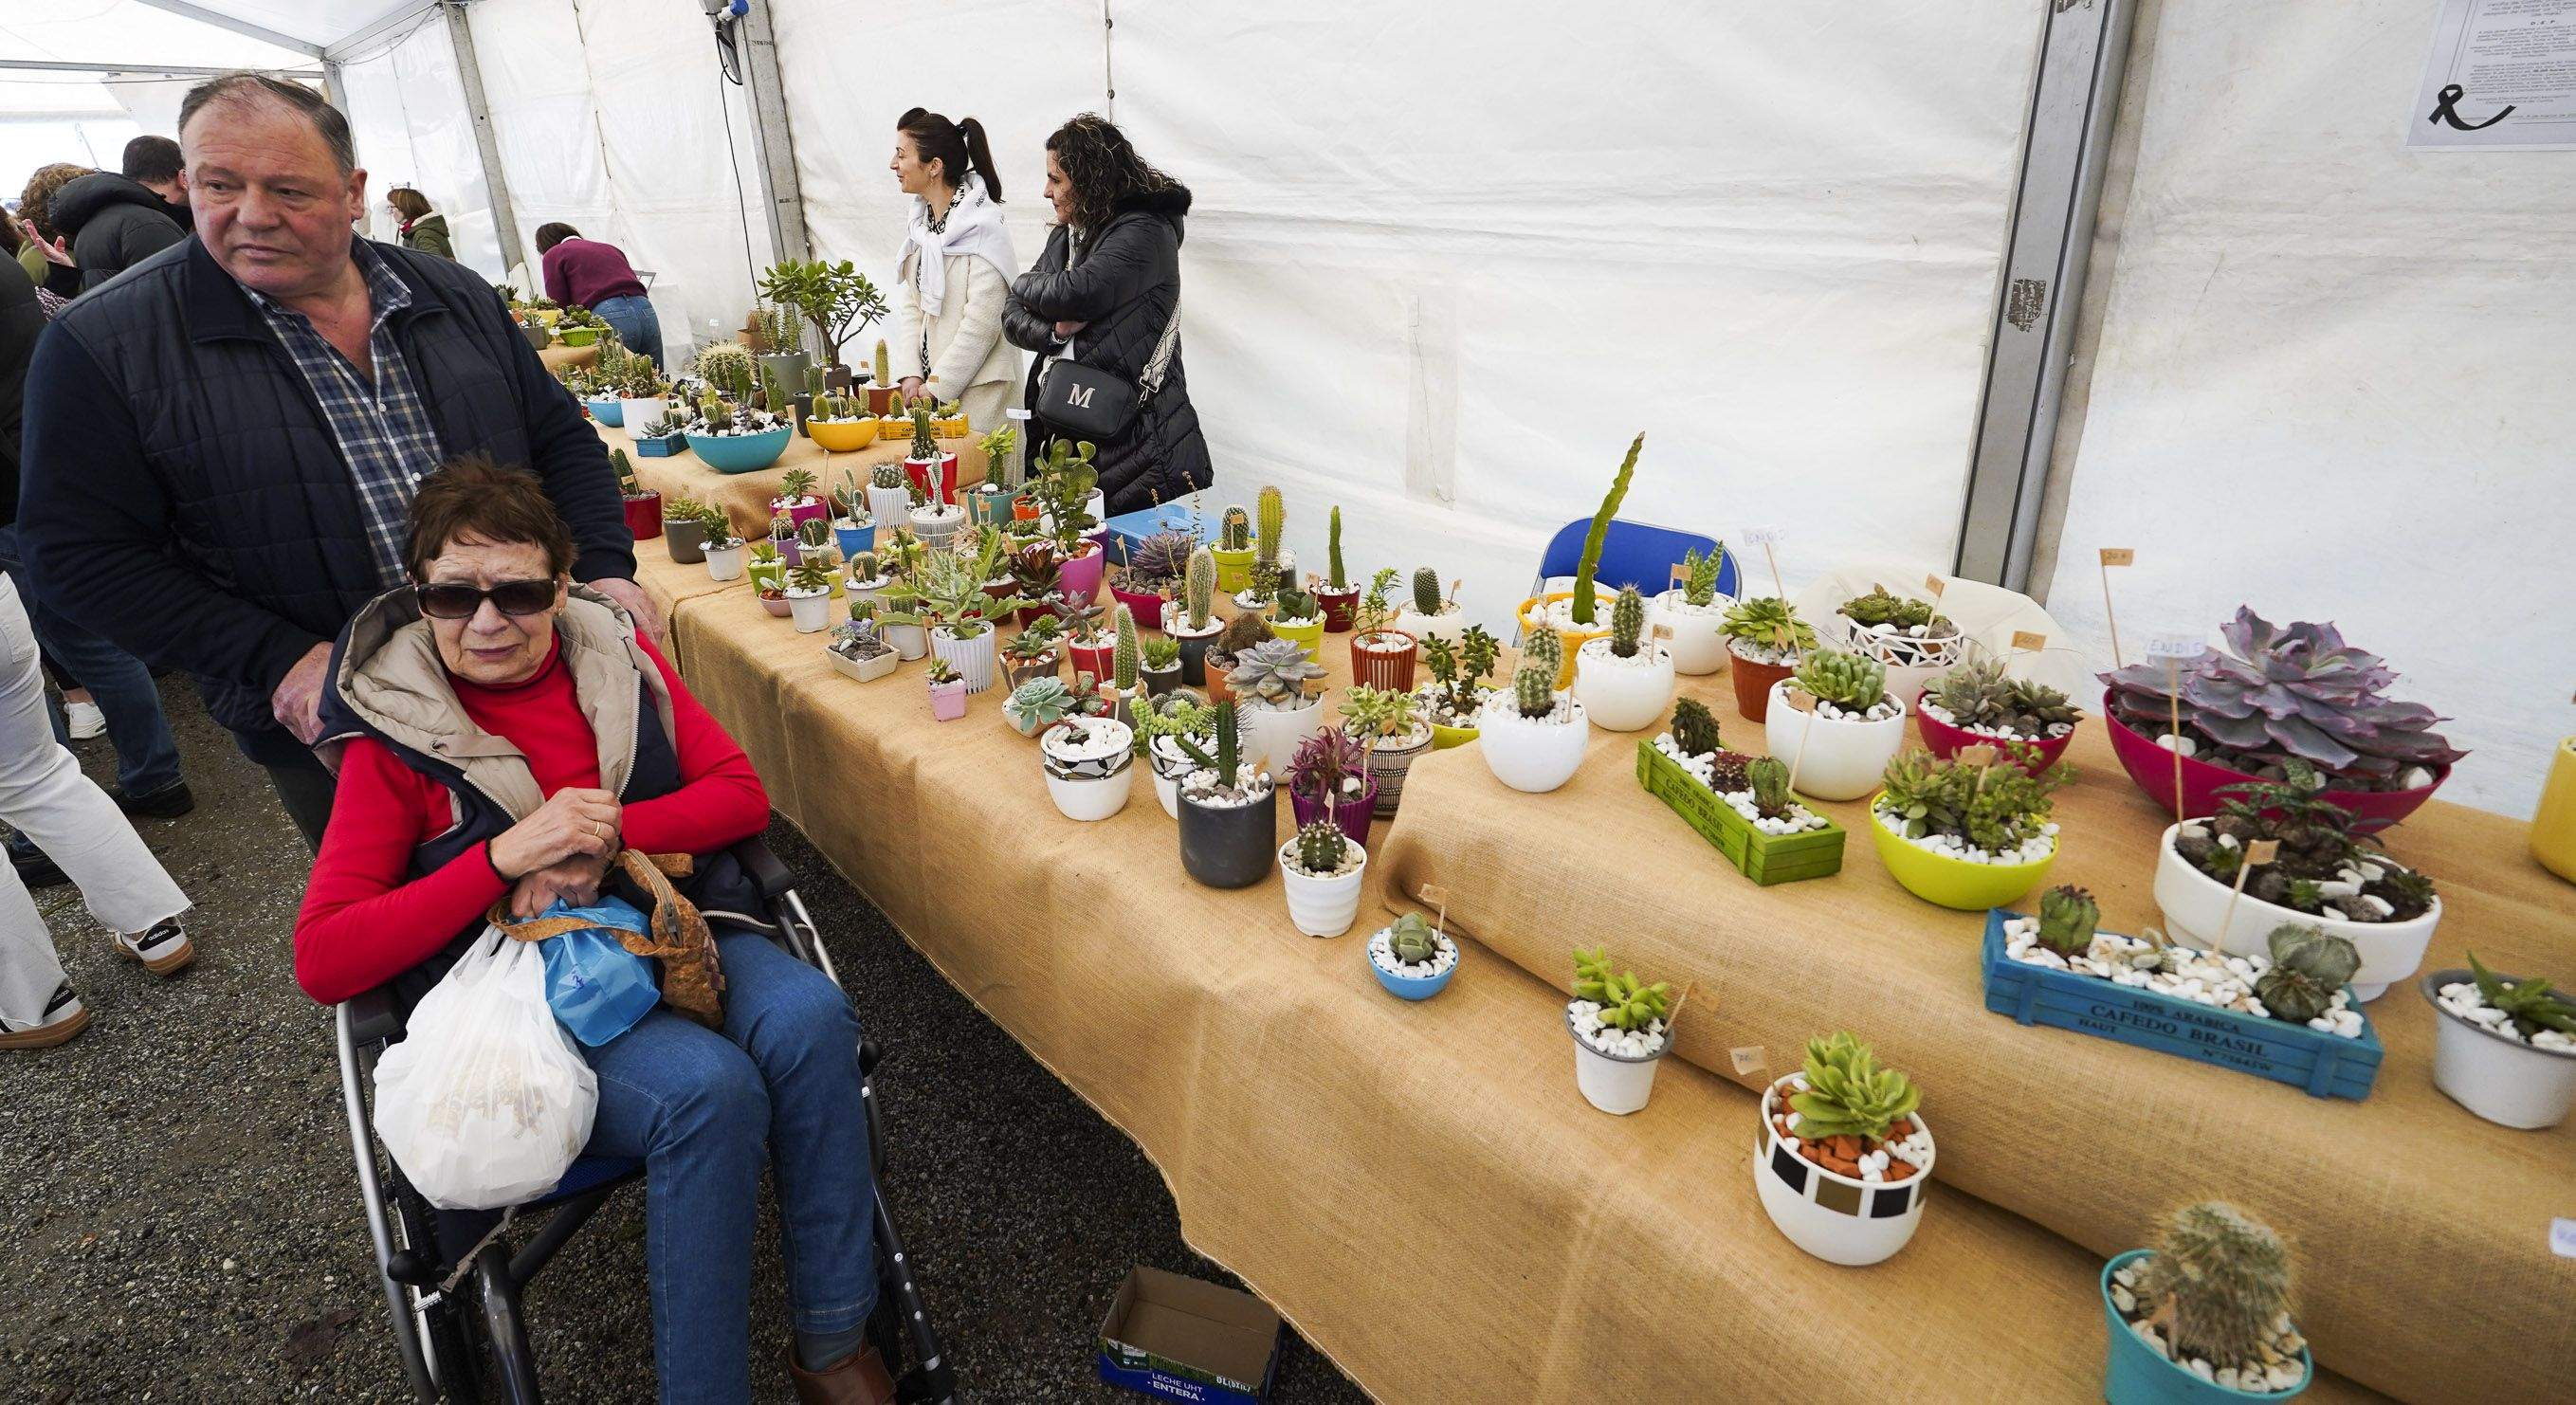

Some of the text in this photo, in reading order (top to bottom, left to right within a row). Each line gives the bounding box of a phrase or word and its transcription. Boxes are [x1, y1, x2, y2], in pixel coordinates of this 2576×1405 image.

[1067, 383, 1096, 409] M
[148, 929, 170, 941] adidas
[2078, 1019, 2117, 1033] HAUT
[2174, 1011, 2241, 1032] ARABICA
[2189, 1029, 2268, 1056] BRASIL
[1152, 1372, 1203, 1394] LECHE UHT
[1153, 1380, 1199, 1401] ENTERA
